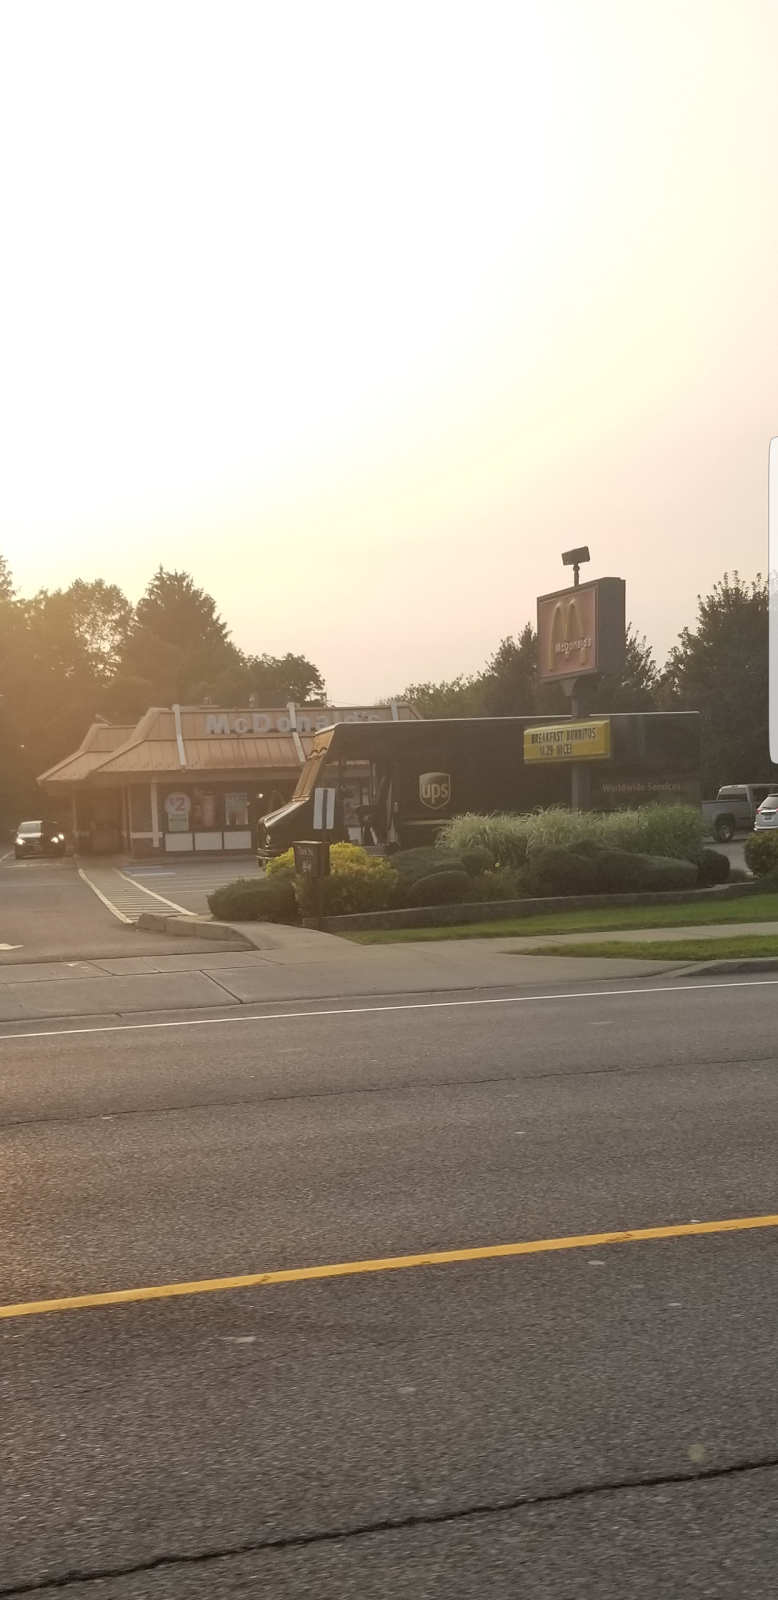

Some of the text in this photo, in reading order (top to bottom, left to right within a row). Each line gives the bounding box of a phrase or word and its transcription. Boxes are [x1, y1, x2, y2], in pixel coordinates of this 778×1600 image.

[555, 637, 592, 653] McDonald's
[531, 727, 596, 744] BREAKFAST BURRITOS
[539, 744, 572, 756] $1.29 NICE!
[421, 783, 449, 804] ups
[602, 782, 681, 792] Worldwide Services
[169, 797, 186, 811] $2
